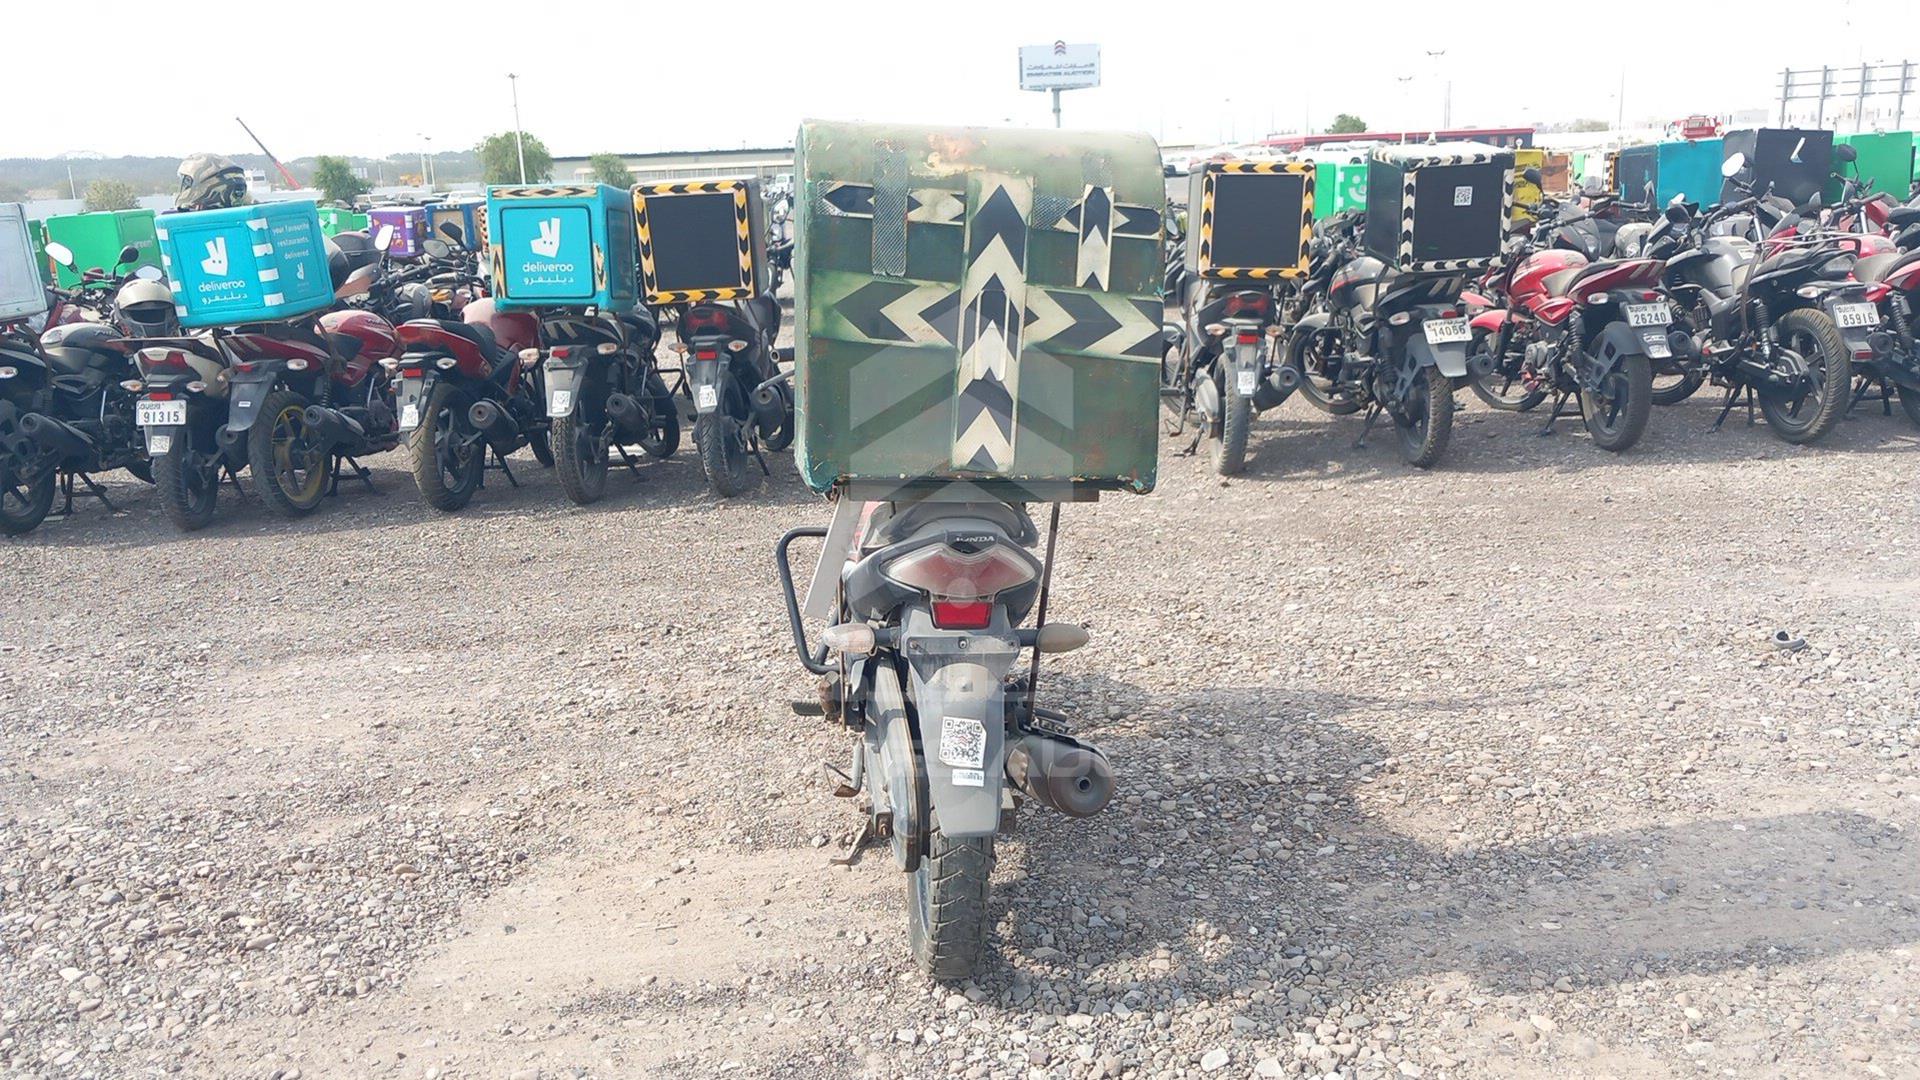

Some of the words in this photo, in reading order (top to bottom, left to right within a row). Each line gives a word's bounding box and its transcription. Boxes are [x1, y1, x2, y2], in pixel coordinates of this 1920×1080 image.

[522, 262, 574, 273] deliveroo
[198, 280, 246, 293] deliveroo
[1634, 312, 1666, 324] 26240
[1843, 312, 1874, 325] 85916
[143, 411, 179, 423] 91315
